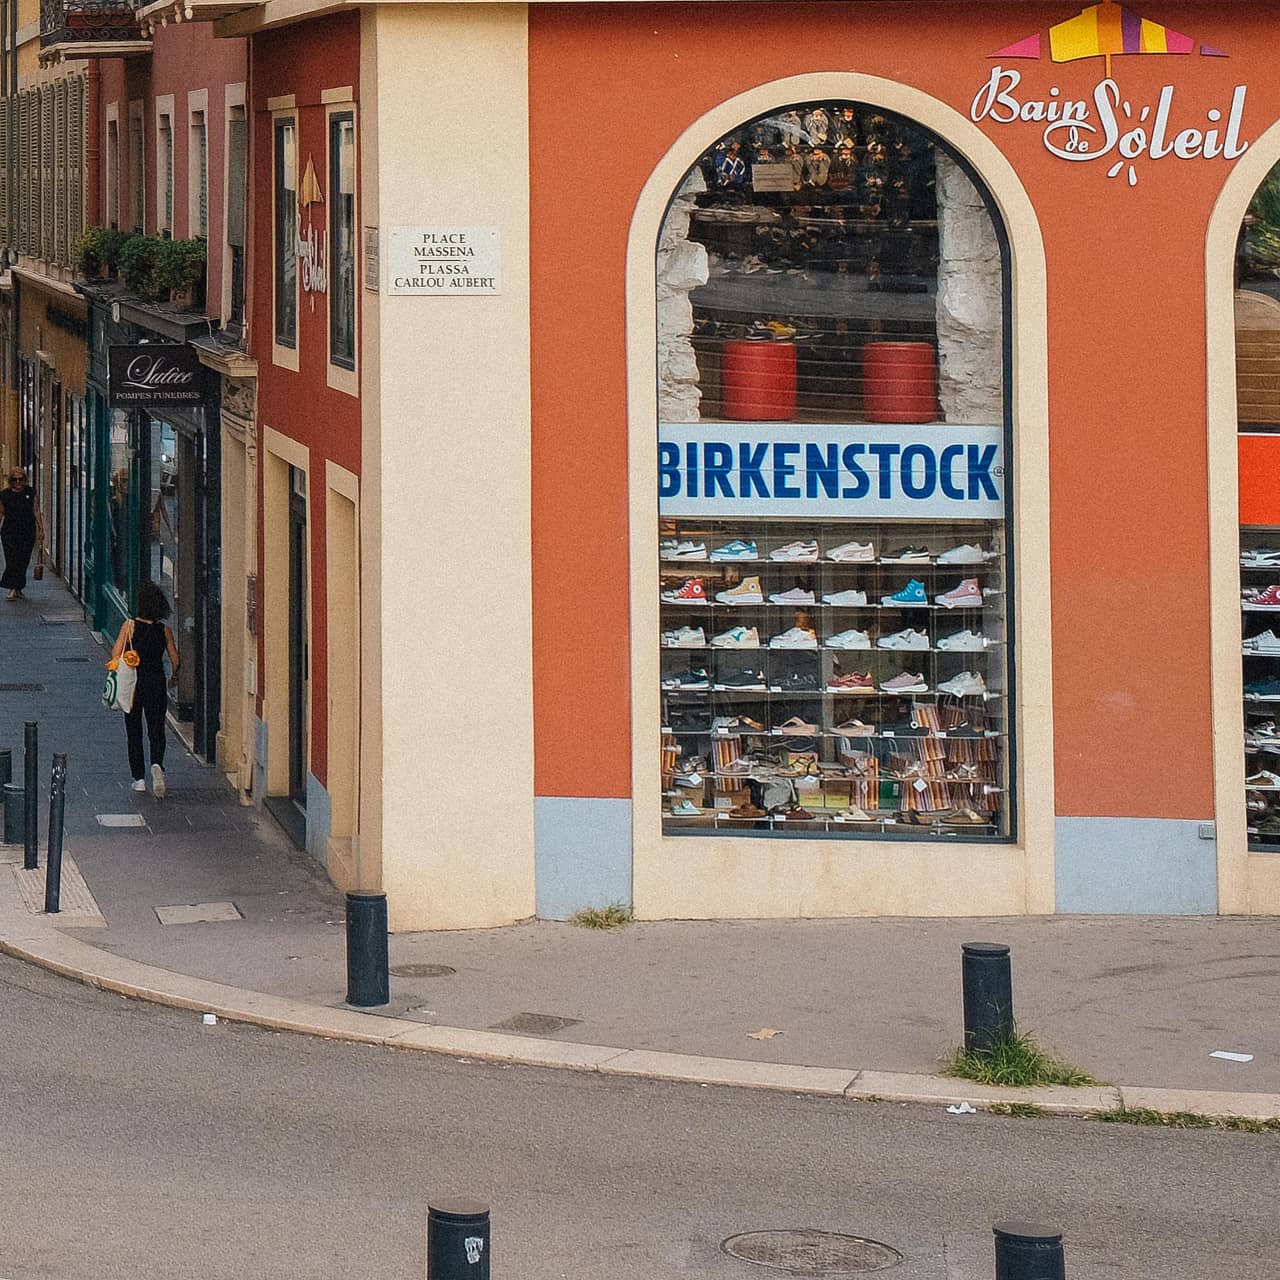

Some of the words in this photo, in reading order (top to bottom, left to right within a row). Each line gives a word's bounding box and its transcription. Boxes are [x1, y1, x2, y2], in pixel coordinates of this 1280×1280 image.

[970, 66, 1090, 122] Bain
[1043, 78, 1249, 161] Soleil
[1065, 125, 1089, 152] de
[423, 233, 466, 243] PLACE
[414, 246, 475, 256] MASSENA
[420, 264, 470, 274] PLASSA
[394, 277, 445, 288] CARLOU
[449, 277, 495, 288] AUBERT
[120, 355, 193, 389] Lutèce
[116, 392, 152, 400] POMPES
[659, 442, 1001, 501] BIRKENSTOCK
